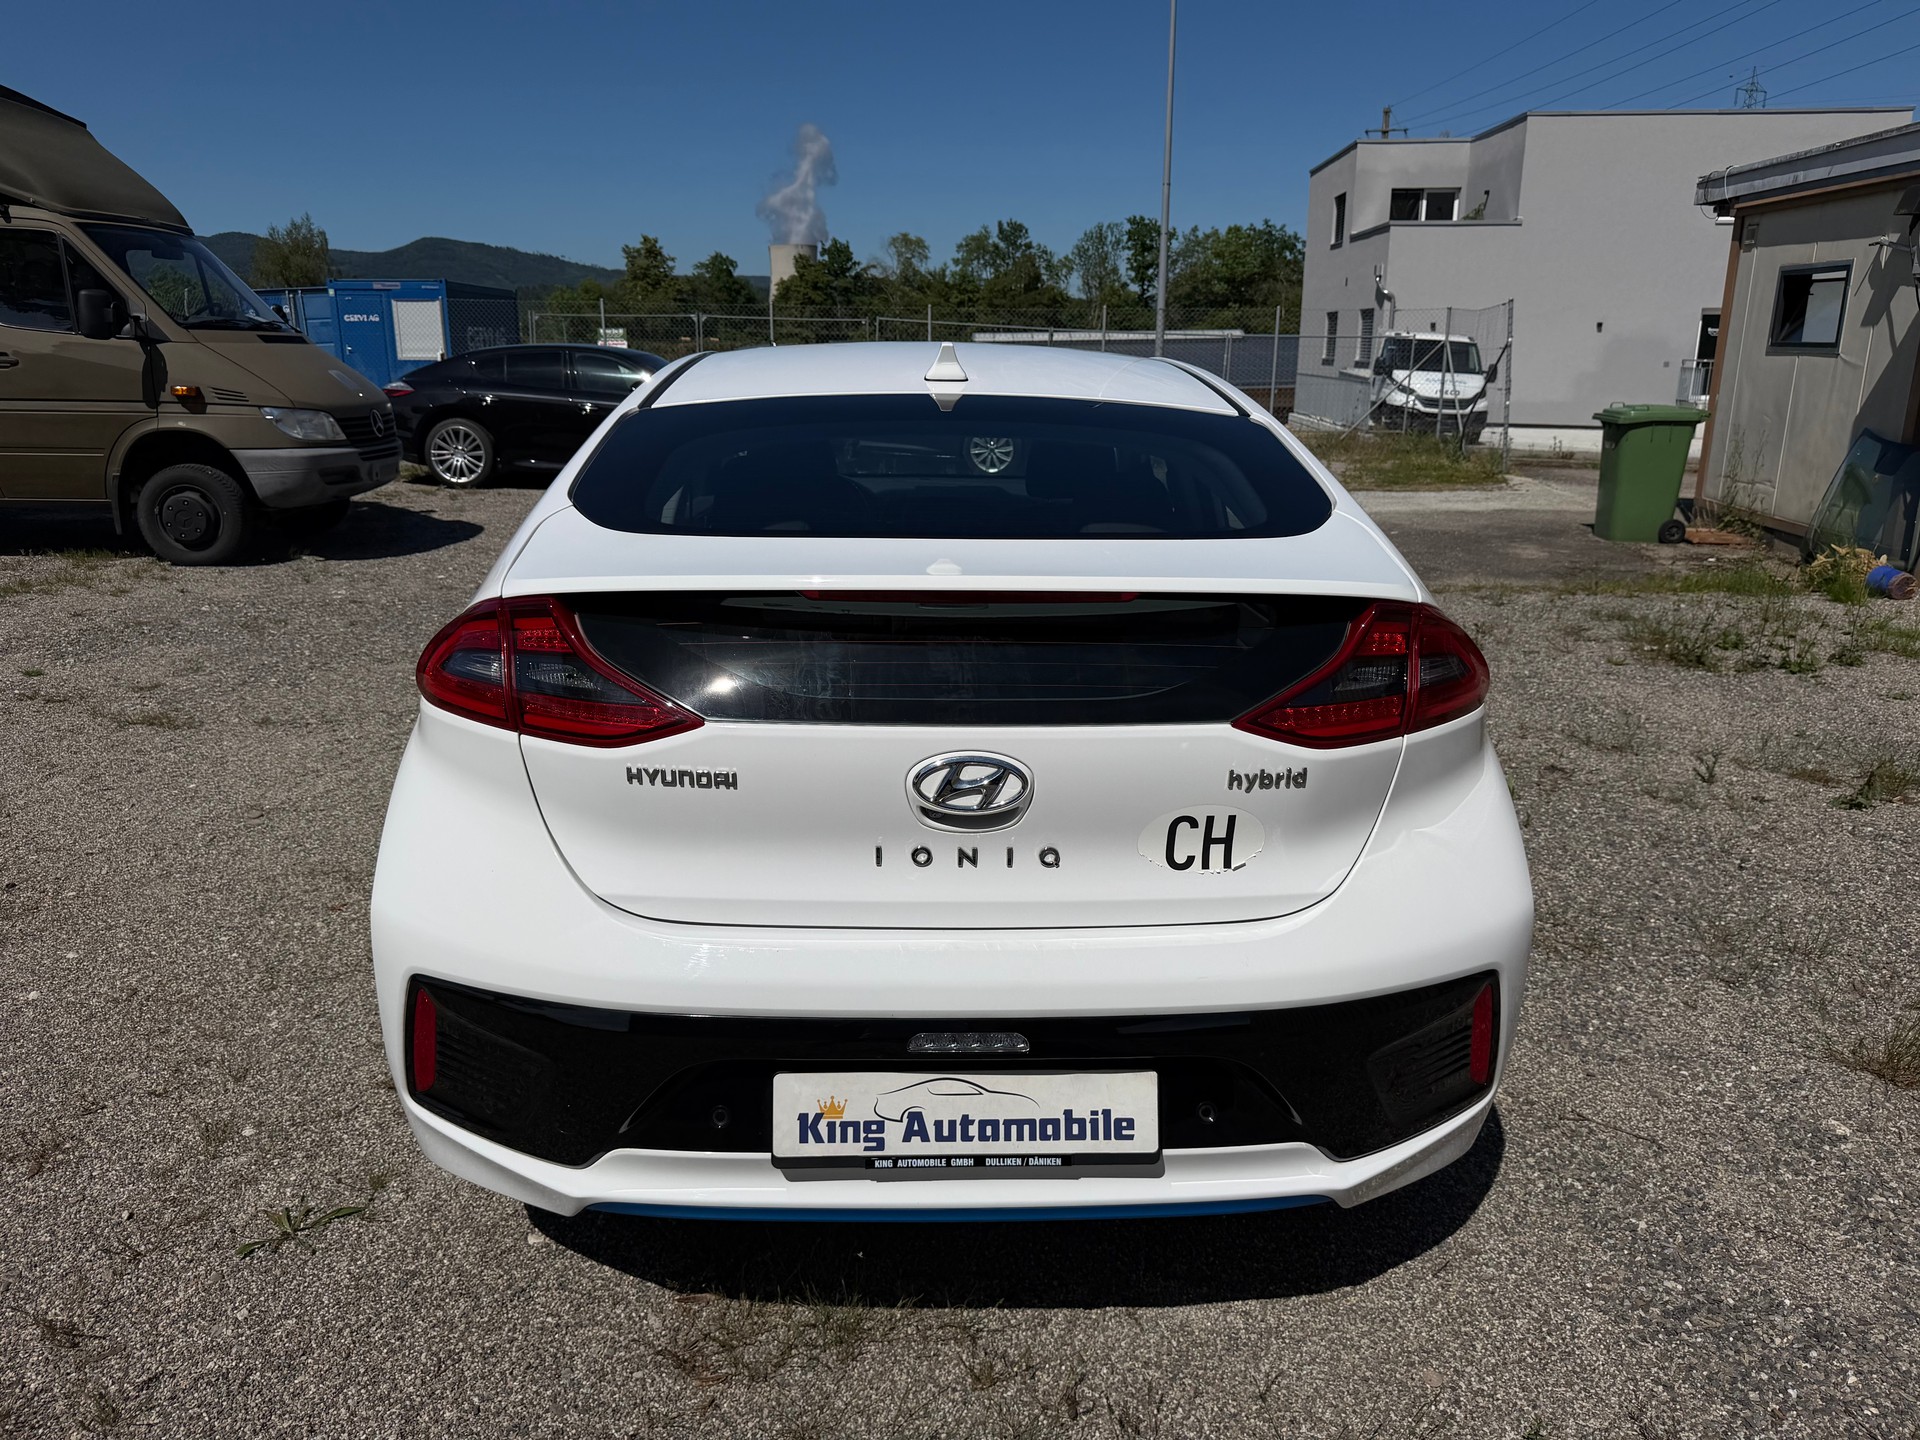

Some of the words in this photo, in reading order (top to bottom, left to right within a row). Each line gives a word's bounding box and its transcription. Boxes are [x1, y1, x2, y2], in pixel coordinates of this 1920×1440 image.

[626, 766, 738, 790] HYUNDAI
[1227, 767, 1308, 794] hybrid
[1165, 815, 1237, 871] CH
[875, 845, 1061, 869] IONIQ
[797, 1111, 885, 1152] King
[902, 1108, 1135, 1143] Automobile
[874, 1159, 893, 1168] KING
[897, 1158, 947, 1167] AUTOMOBILE
[951, 1158, 974, 1167] GMBH
[985, 1157, 1022, 1166] DULLIKEN
[1028, 1156, 1062, 1166] DÄNIKEN
